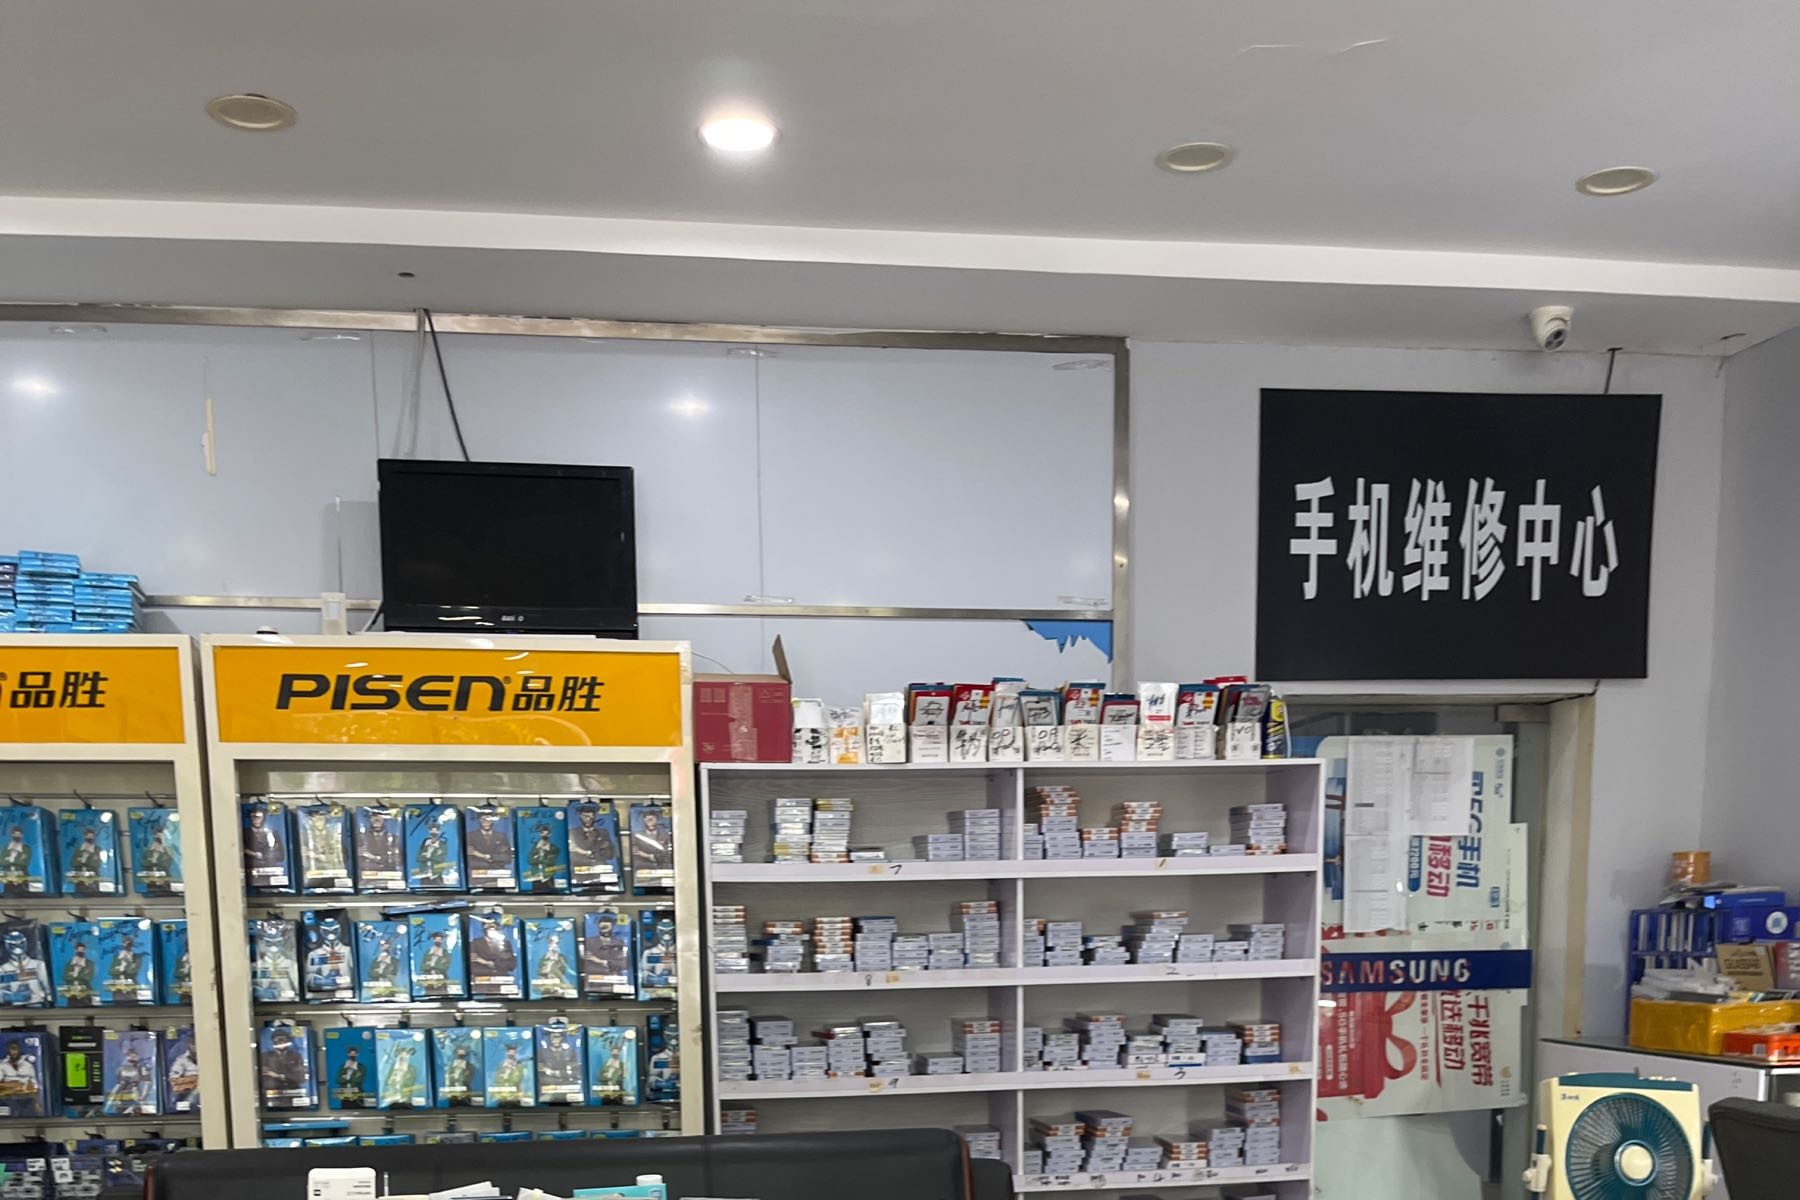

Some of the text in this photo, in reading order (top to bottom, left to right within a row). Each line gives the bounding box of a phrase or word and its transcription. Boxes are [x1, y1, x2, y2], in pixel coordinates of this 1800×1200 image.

[1290, 477, 1619, 601] 手机维修中心
[10, 671, 109, 708] 品胜
[275, 673, 605, 712] PISEN 品胜
[1426, 835, 1453, 898] 移动
[1320, 957, 1471, 986] SAMSUNG
